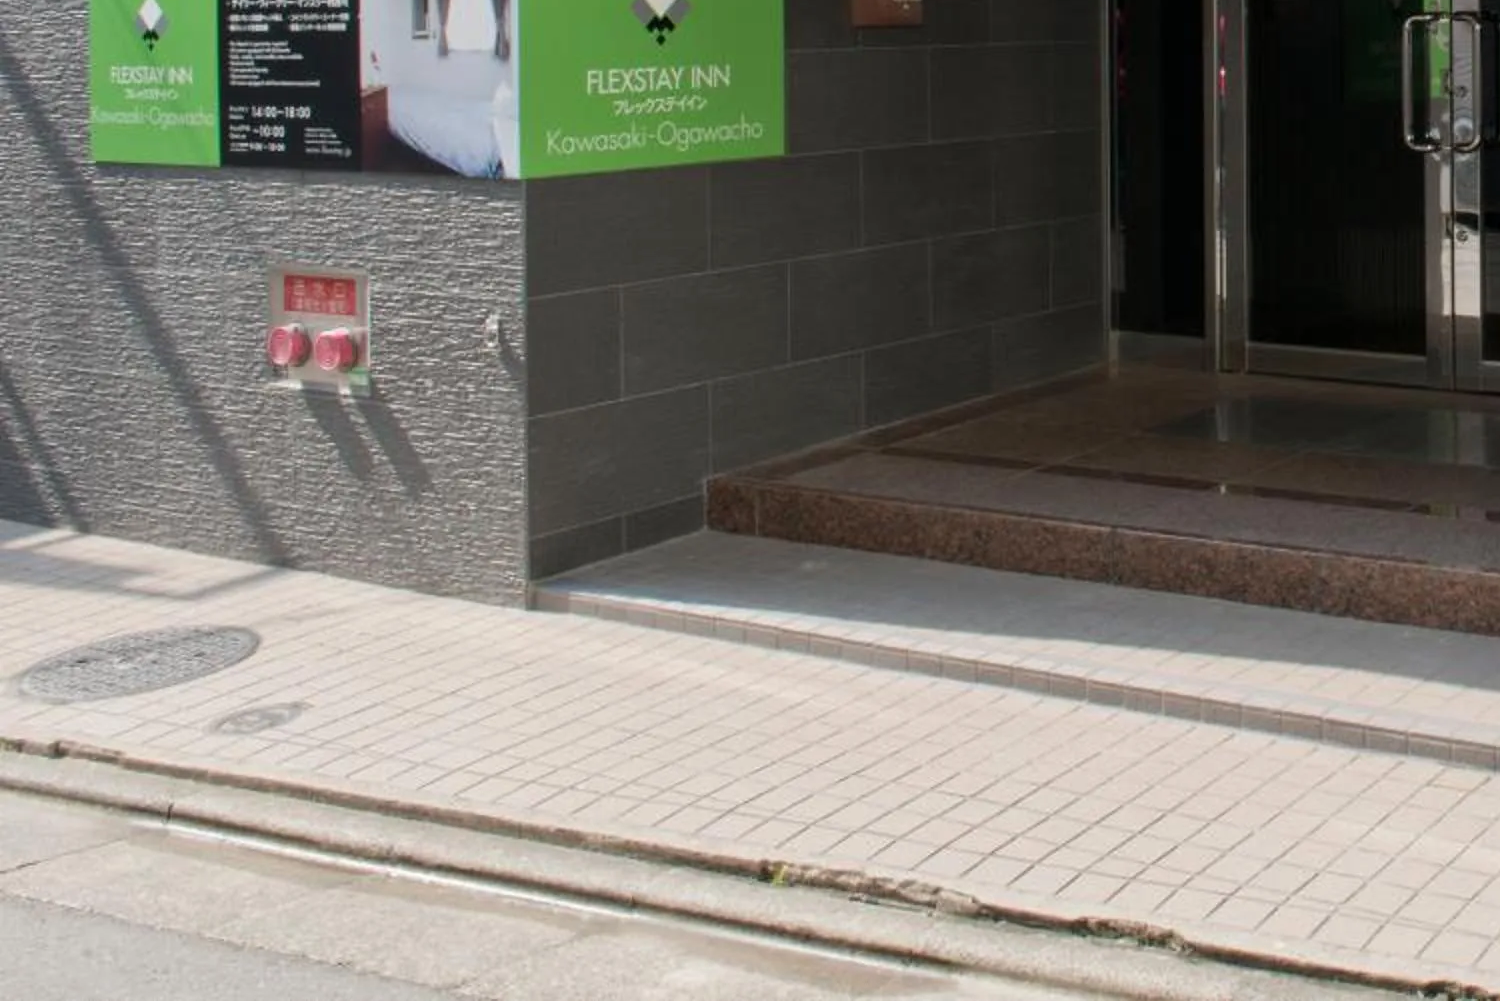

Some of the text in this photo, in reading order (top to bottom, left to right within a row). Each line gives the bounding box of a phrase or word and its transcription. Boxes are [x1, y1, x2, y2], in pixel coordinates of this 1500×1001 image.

[168, 65, 194, 85] INN
[586, 63, 732, 95] FLEXSTAY INN
[545, 111, 764, 156] Kawasaki-Ogawacho
